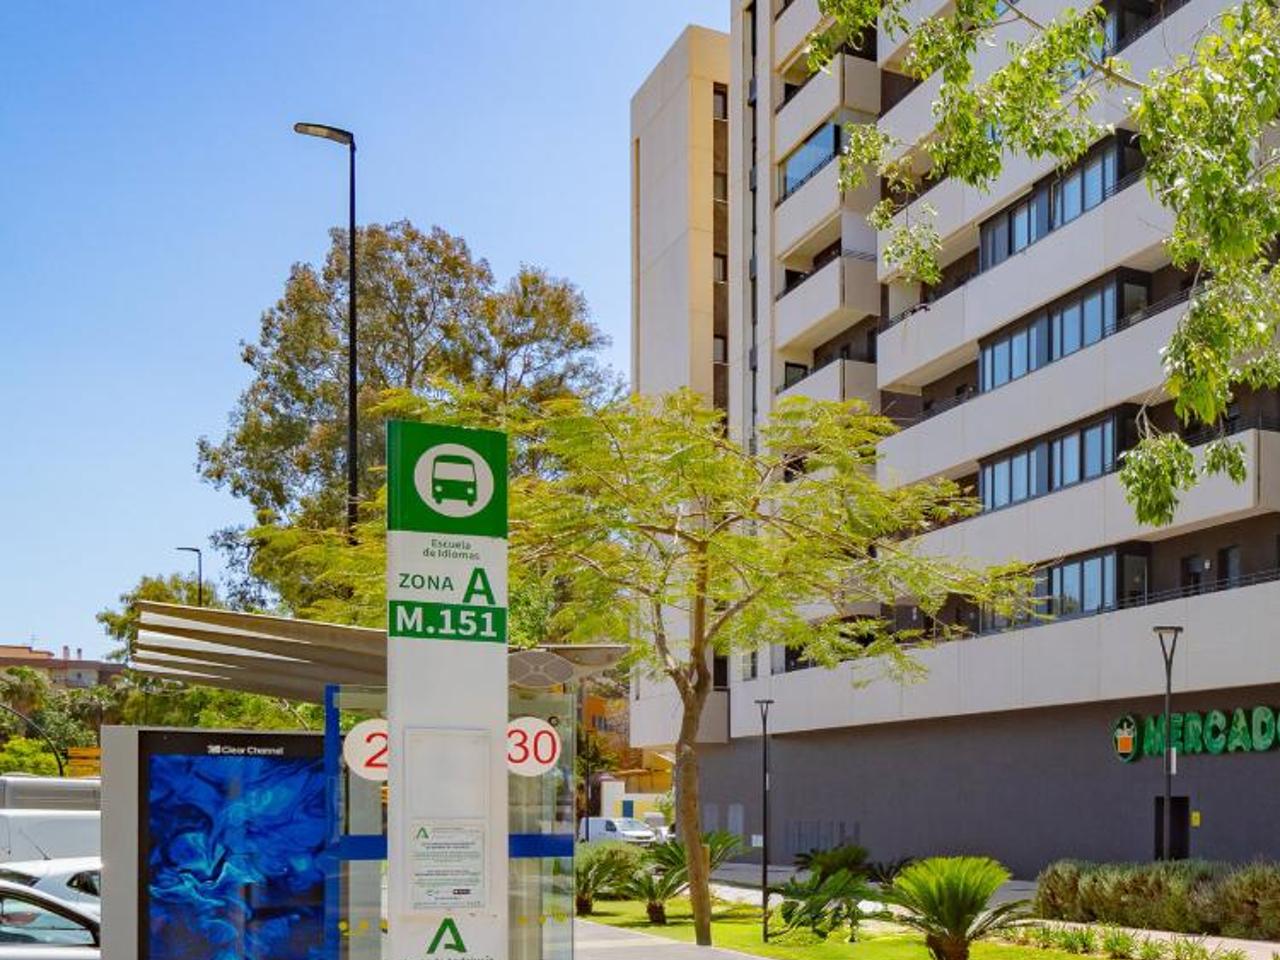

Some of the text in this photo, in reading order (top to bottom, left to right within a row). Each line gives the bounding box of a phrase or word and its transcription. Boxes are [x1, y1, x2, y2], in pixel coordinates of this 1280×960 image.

[422, 547, 480, 560] de Idiomas
[431, 538, 472, 550] Escuela
[398, 567, 496, 605] ZONA A
[396, 605, 497, 638] M.151
[221, 745, 284, 755] Clear Channel
[507, 729, 557, 764] 30
